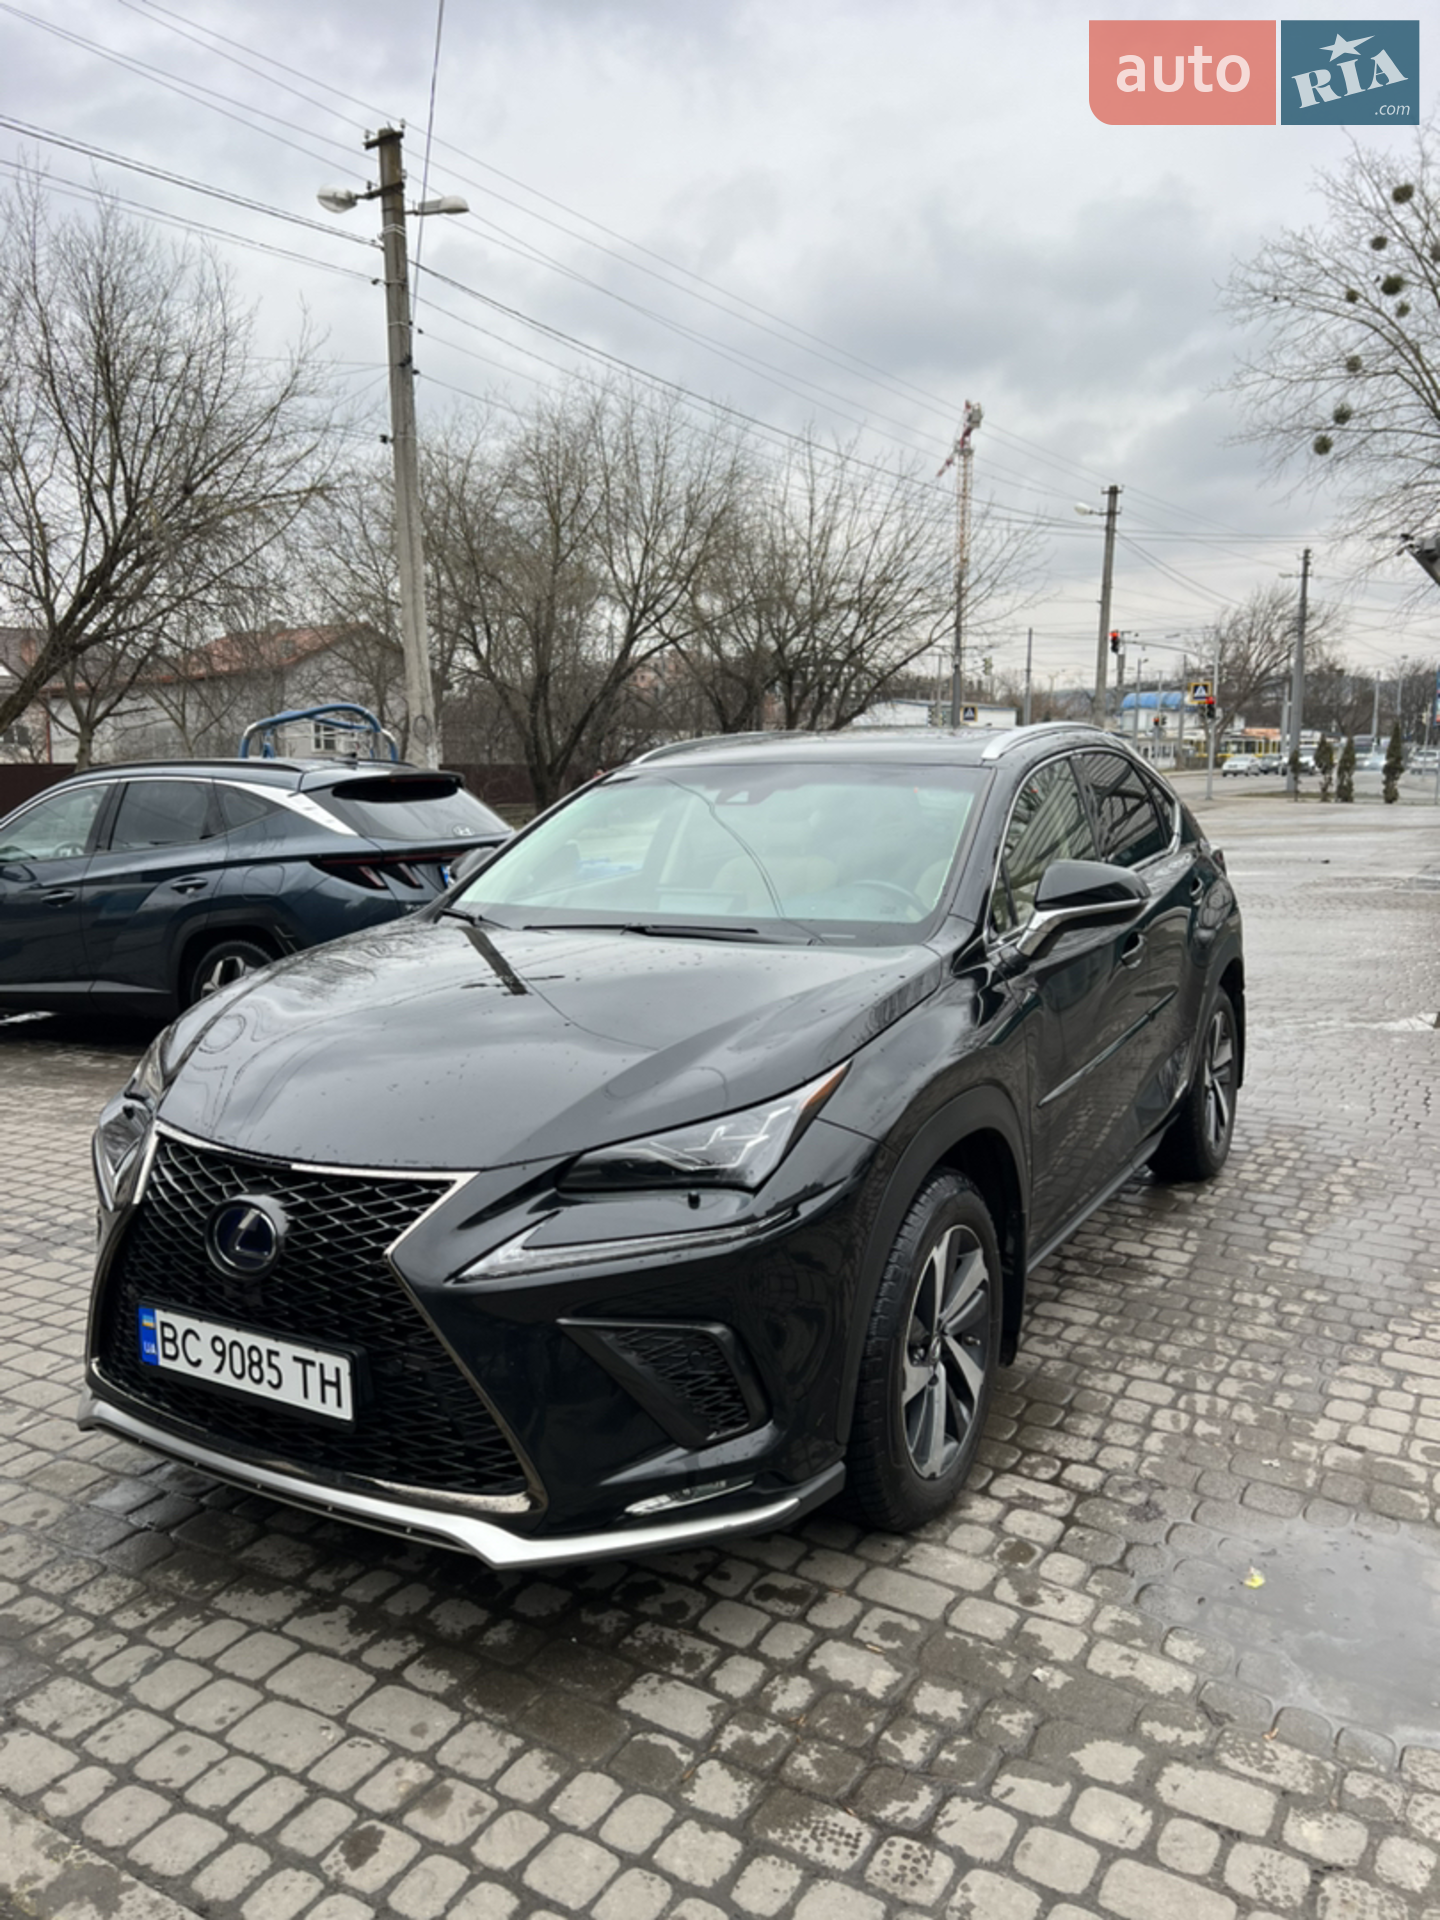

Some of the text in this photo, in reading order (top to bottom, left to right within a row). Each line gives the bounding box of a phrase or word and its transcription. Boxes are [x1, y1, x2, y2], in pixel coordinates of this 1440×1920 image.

[160, 1321, 343, 1409] BC 9085 TH
